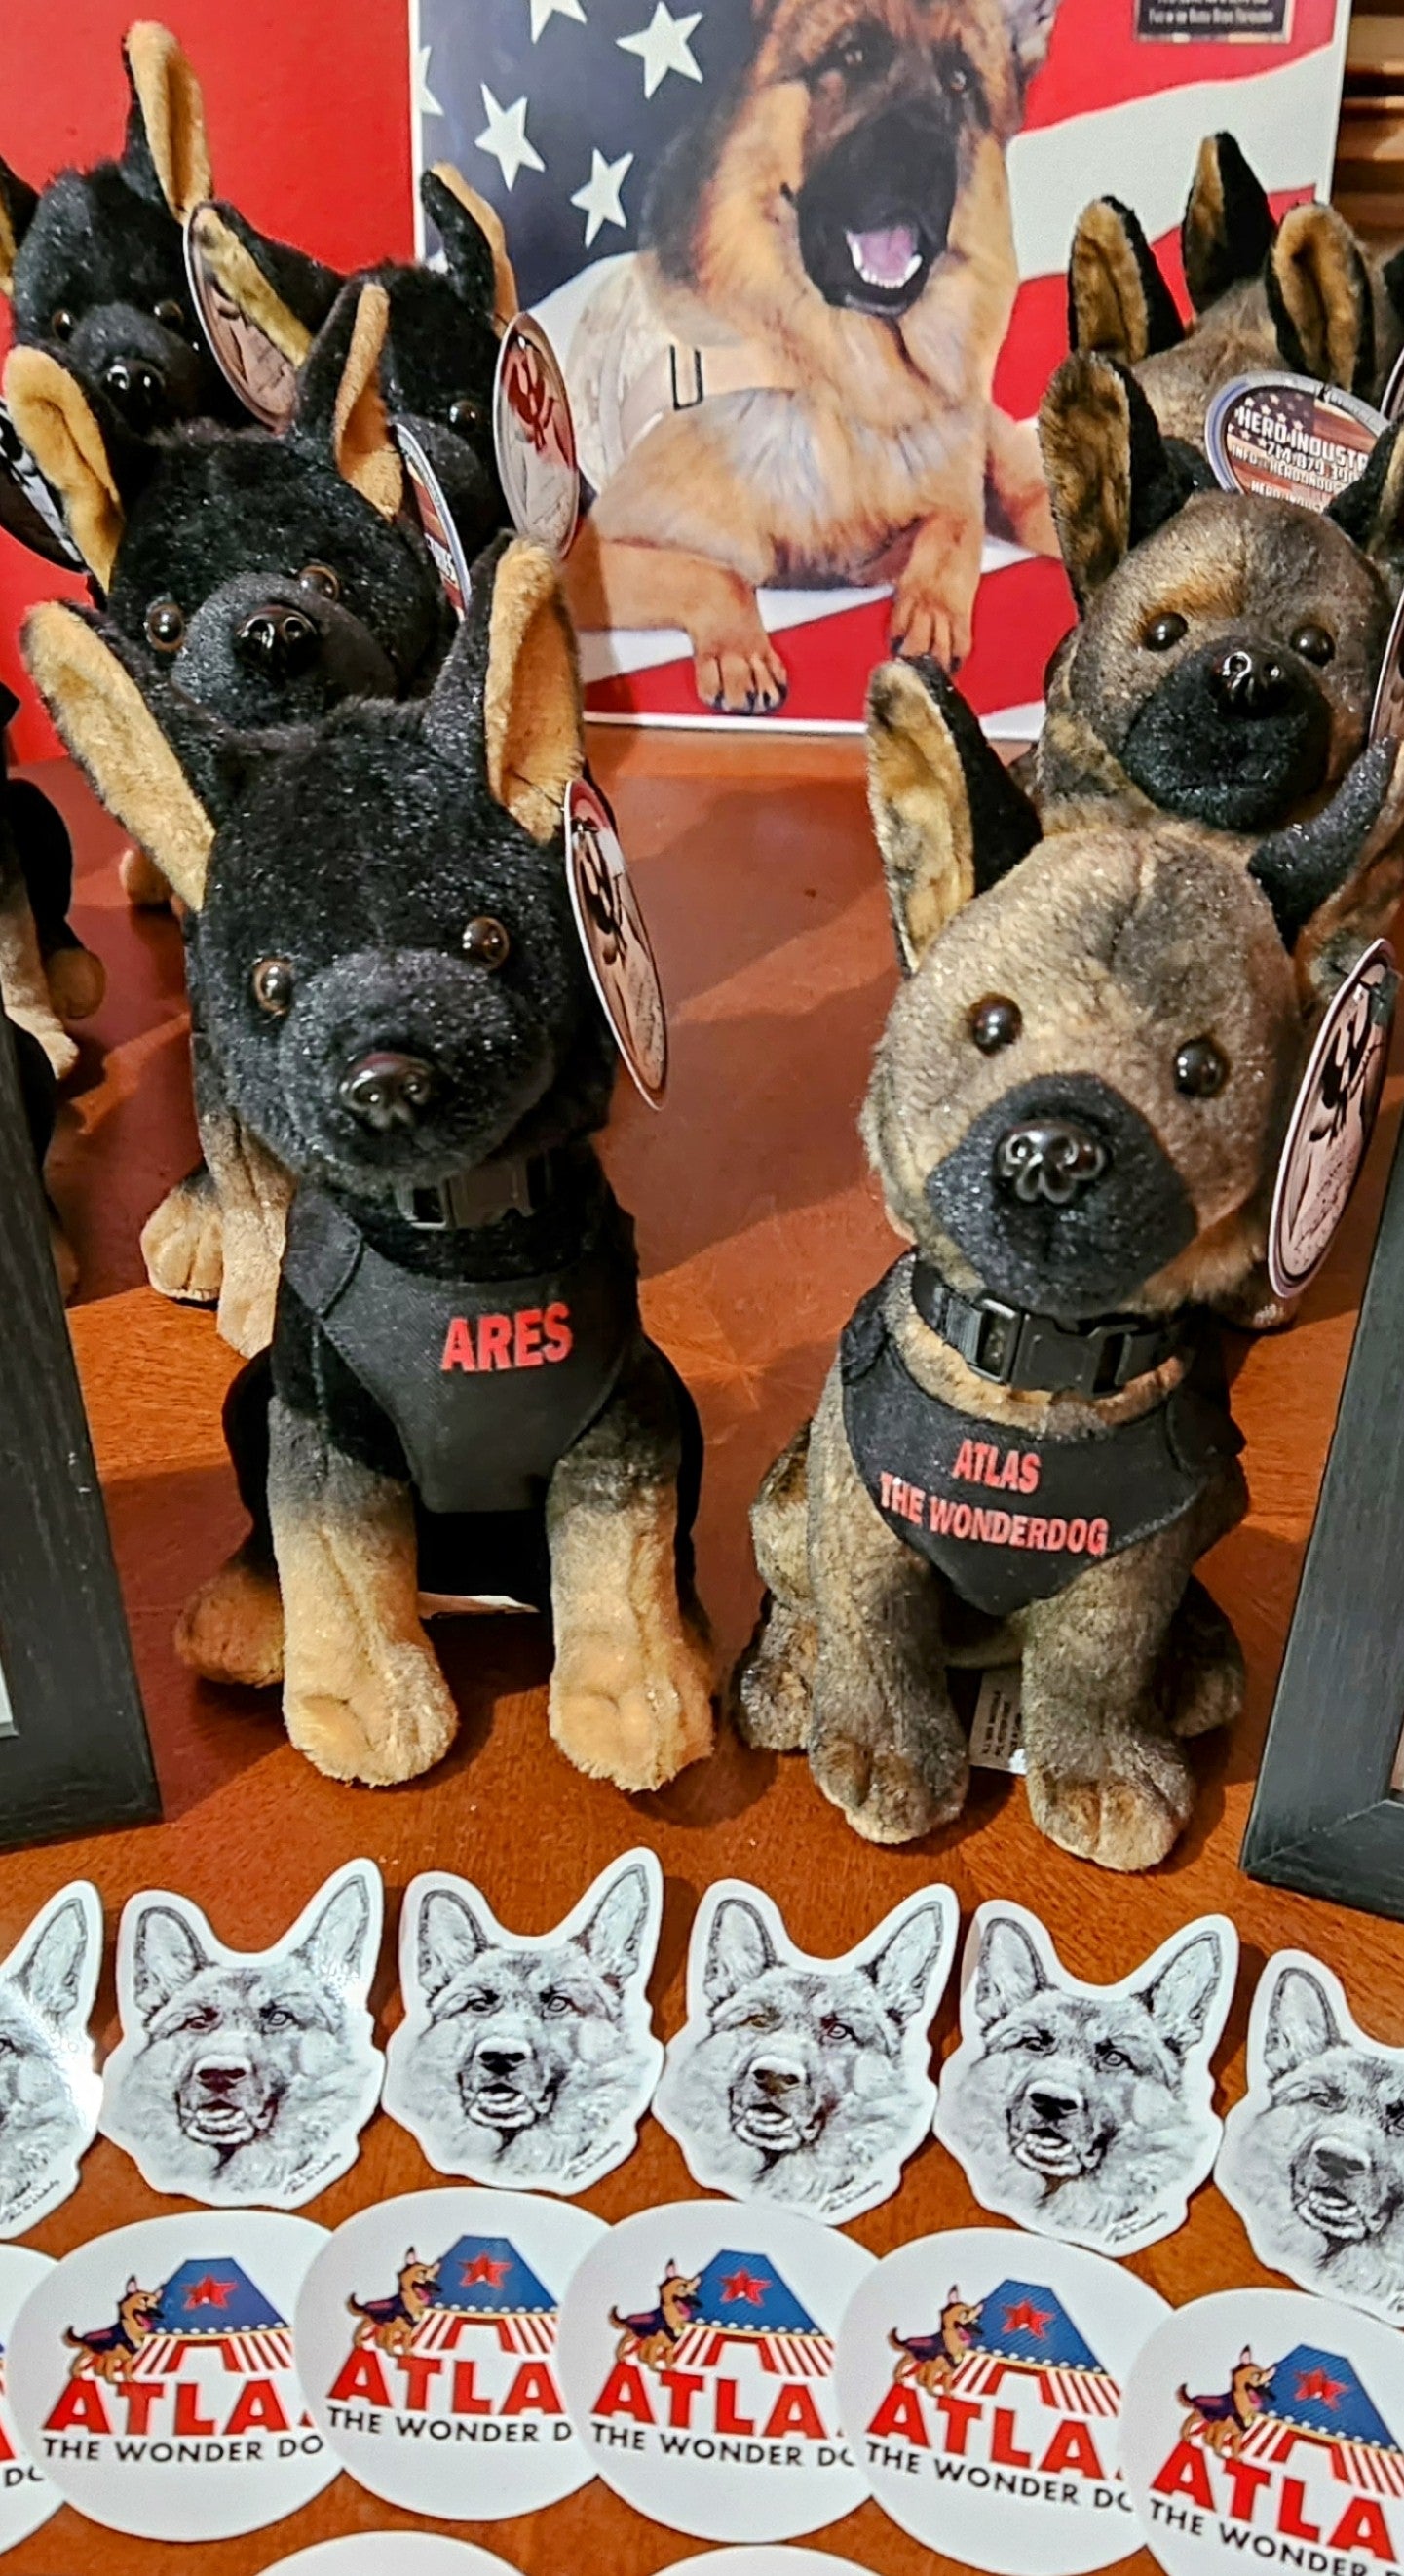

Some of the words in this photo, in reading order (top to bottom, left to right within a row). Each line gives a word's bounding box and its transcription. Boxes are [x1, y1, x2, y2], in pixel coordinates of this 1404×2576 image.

[1237, 405, 1288, 443] HERO
[1291, 430, 1369, 472] INDUSTR
[440, 1301, 573, 1372] ARES
[952, 1438, 1041, 1494] ATLAS
[880, 1471, 926, 1527] THE
[929, 1495, 1109, 1557] WONDERDOG
[42, 2374, 313, 2436] ATLA
[326, 2344, 566, 2416] ATLA
[590, 2360, 844, 2440] ATLA
[43, 2437, 101, 2461] THE
[115, 2441, 263, 2463] WONDER
[278, 2434, 324, 2459] DO
[326, 2405, 382, 2434] THE
[396, 2416, 541, 2442] WONDER
[590, 2422, 647, 2451] THE
[659, 2433, 804, 2466] WONDER
[866, 2381, 1123, 2480] ATLA
[865, 2441, 922, 2474] THE
[933, 2457, 1080, 2506] WONDER
[1149, 2438, 1398, 2564] ATLA
[1150, 2497, 1205, 2536] THE
[1218, 2521, 1369, 2576] WONDER
